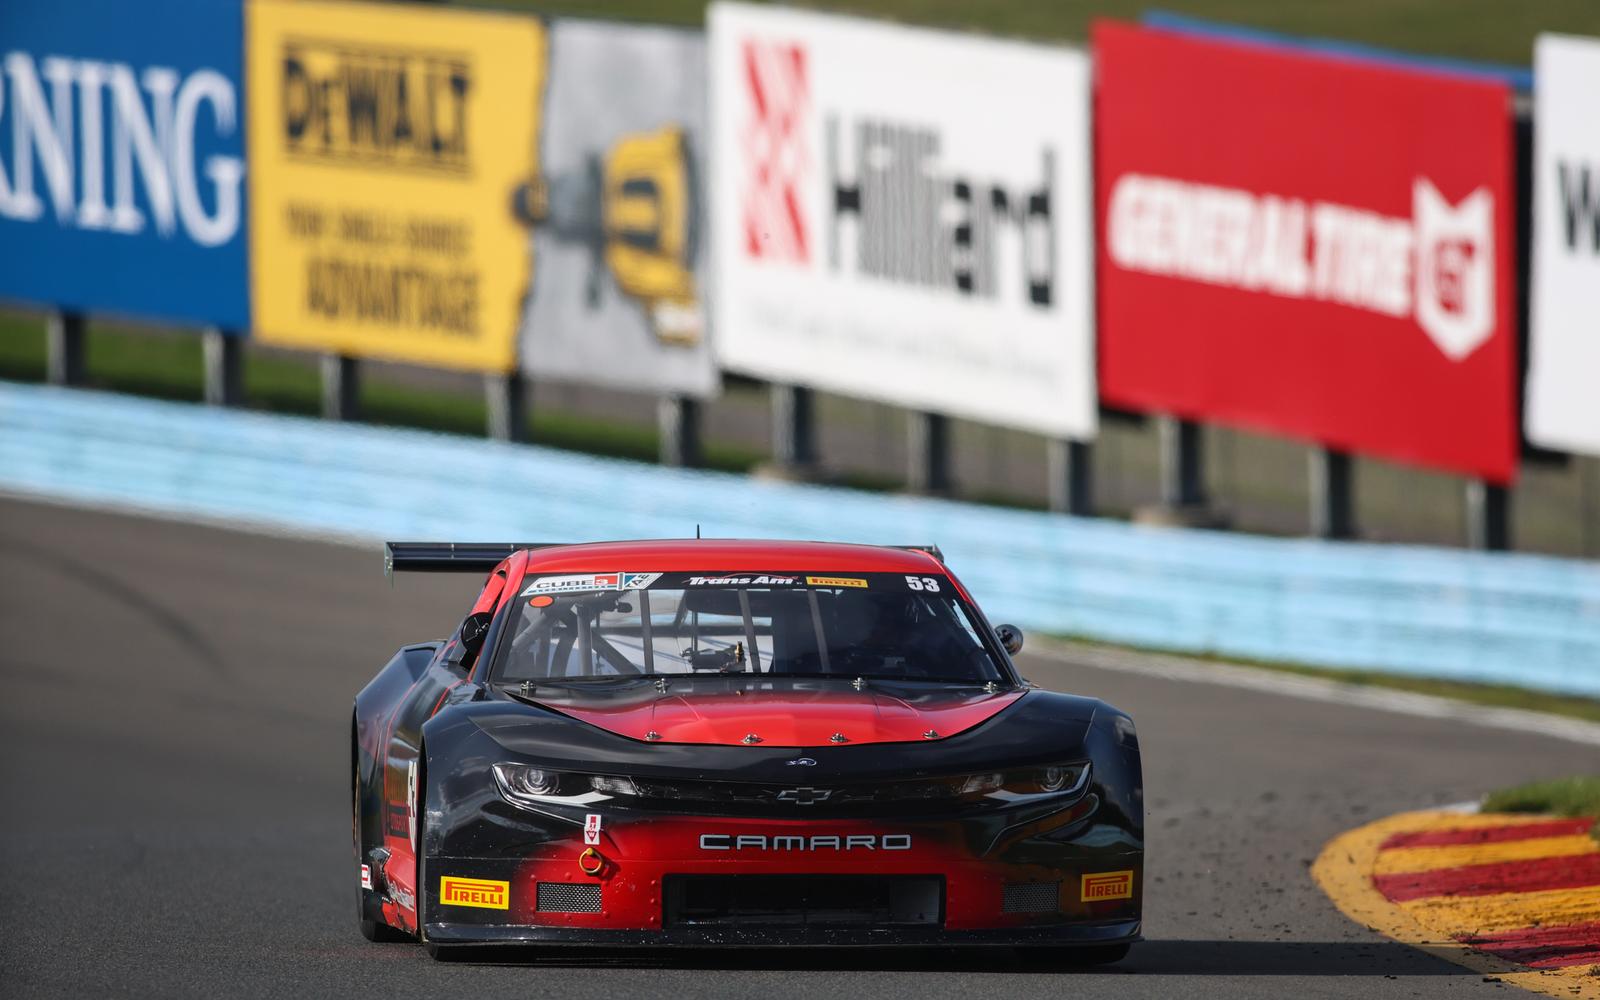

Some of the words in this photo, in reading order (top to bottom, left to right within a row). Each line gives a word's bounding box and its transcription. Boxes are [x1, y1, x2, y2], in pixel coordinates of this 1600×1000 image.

[0, 51, 245, 248] NING
[826, 111, 1057, 308] Hilliard
[690, 576, 751, 586] Trans
[752, 576, 793, 585] Am
[811, 578, 862, 586] PIRELLI
[905, 576, 940, 593] 53
[700, 834, 911, 850] CAMARO
[445, 881, 504, 905] PIRELLI
[1085, 875, 1129, 897] PIRELLI
